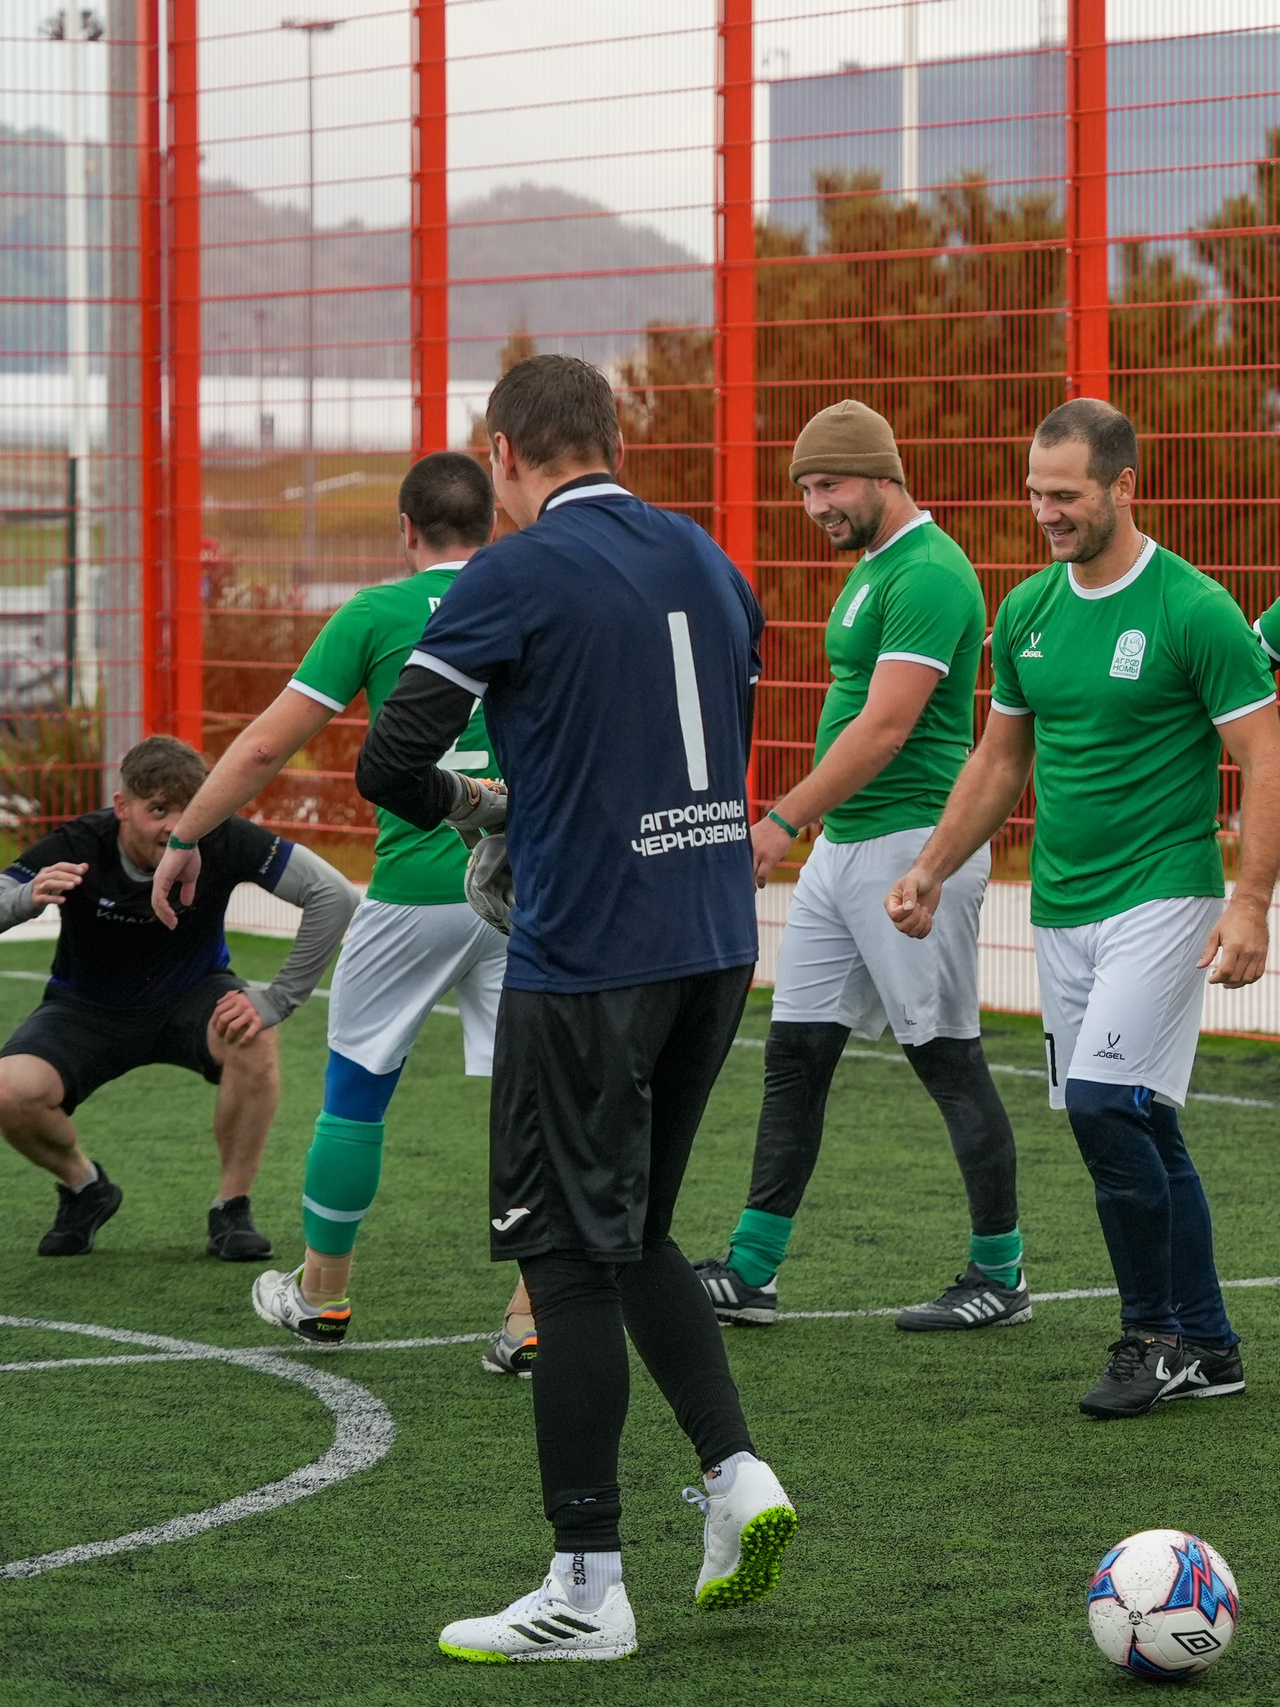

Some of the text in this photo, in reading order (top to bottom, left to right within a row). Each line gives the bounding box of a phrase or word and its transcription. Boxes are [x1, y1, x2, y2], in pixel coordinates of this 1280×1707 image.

[1019, 649, 1044, 658] JÖGEL
[1112, 664, 1139, 674] НОМЫ
[667, 611, 709, 791] 1
[640, 798, 745, 834] АГРОНОМЫ
[1092, 1049, 1126, 1061] JÖGEL
